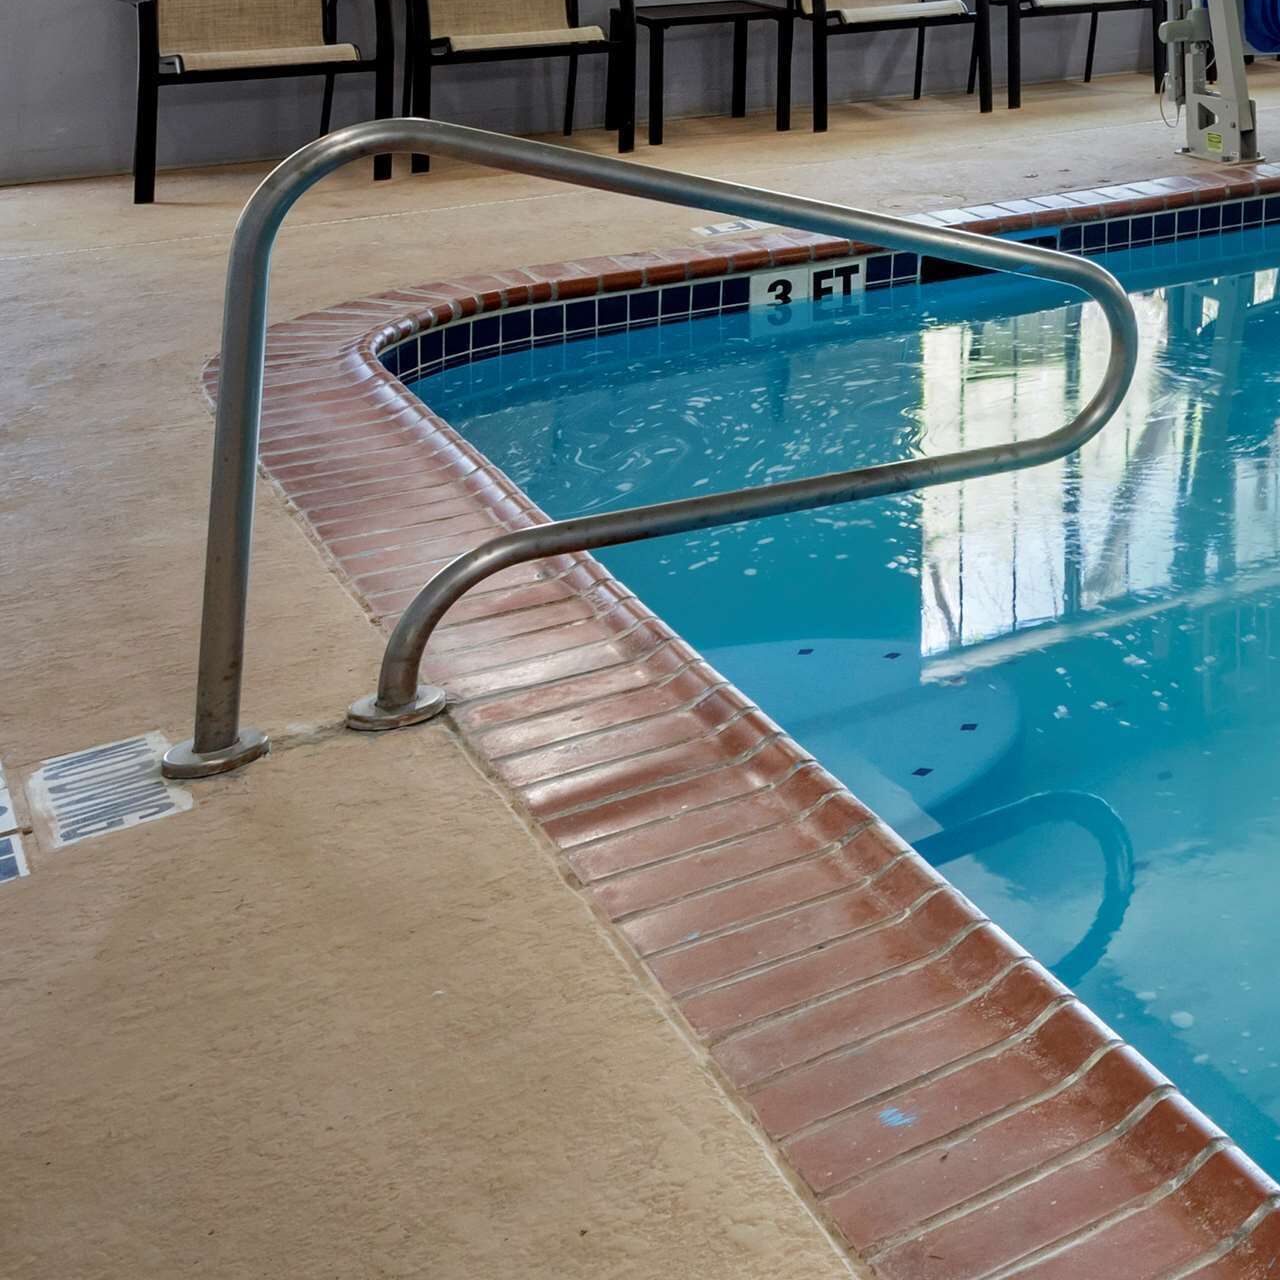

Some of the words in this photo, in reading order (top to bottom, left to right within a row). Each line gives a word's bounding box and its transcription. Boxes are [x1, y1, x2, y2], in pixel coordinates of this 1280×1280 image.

[767, 279, 793, 307] 3
[813, 264, 861, 303] FT
[42, 737, 156, 781] NO
[48, 758, 176, 842] DIVING
